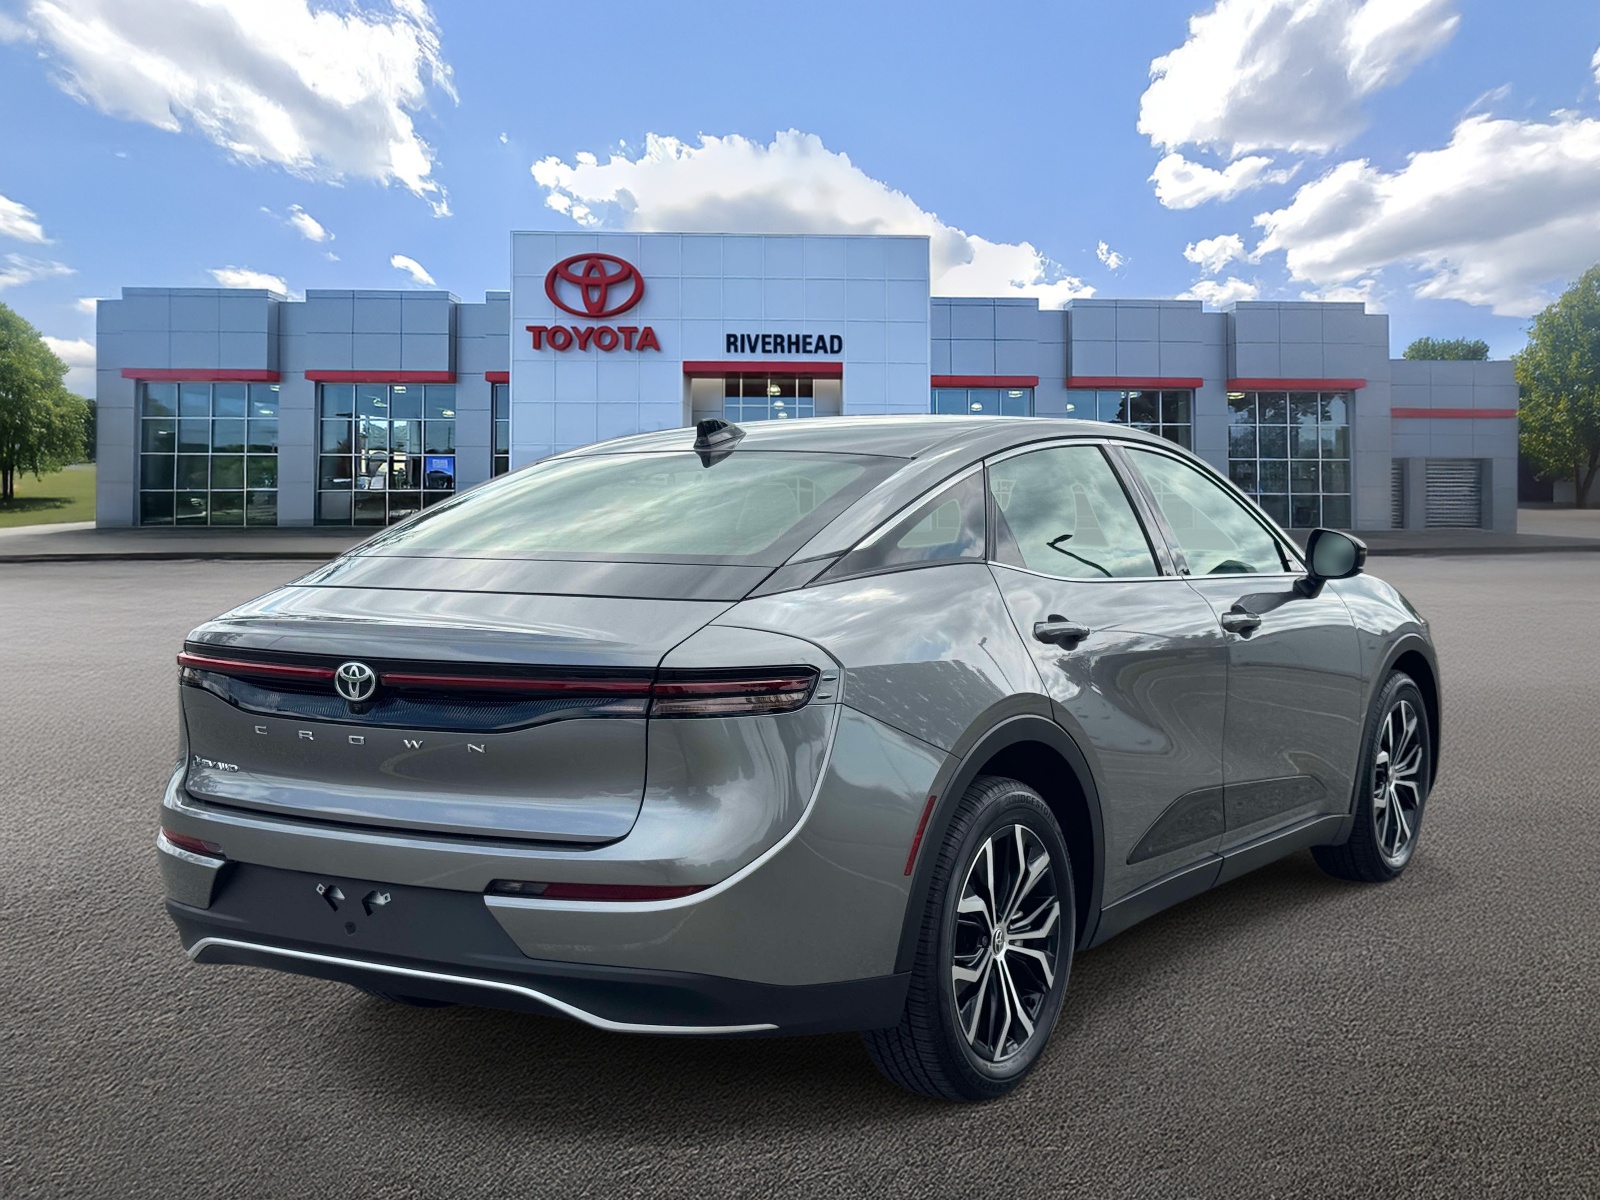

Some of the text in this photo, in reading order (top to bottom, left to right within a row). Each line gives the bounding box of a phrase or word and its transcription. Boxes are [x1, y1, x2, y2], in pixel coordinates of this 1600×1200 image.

[525, 325, 661, 352] TOYOTA
[725, 333, 843, 355] RIVERHEAD
[254, 725, 486, 753] CROWN
